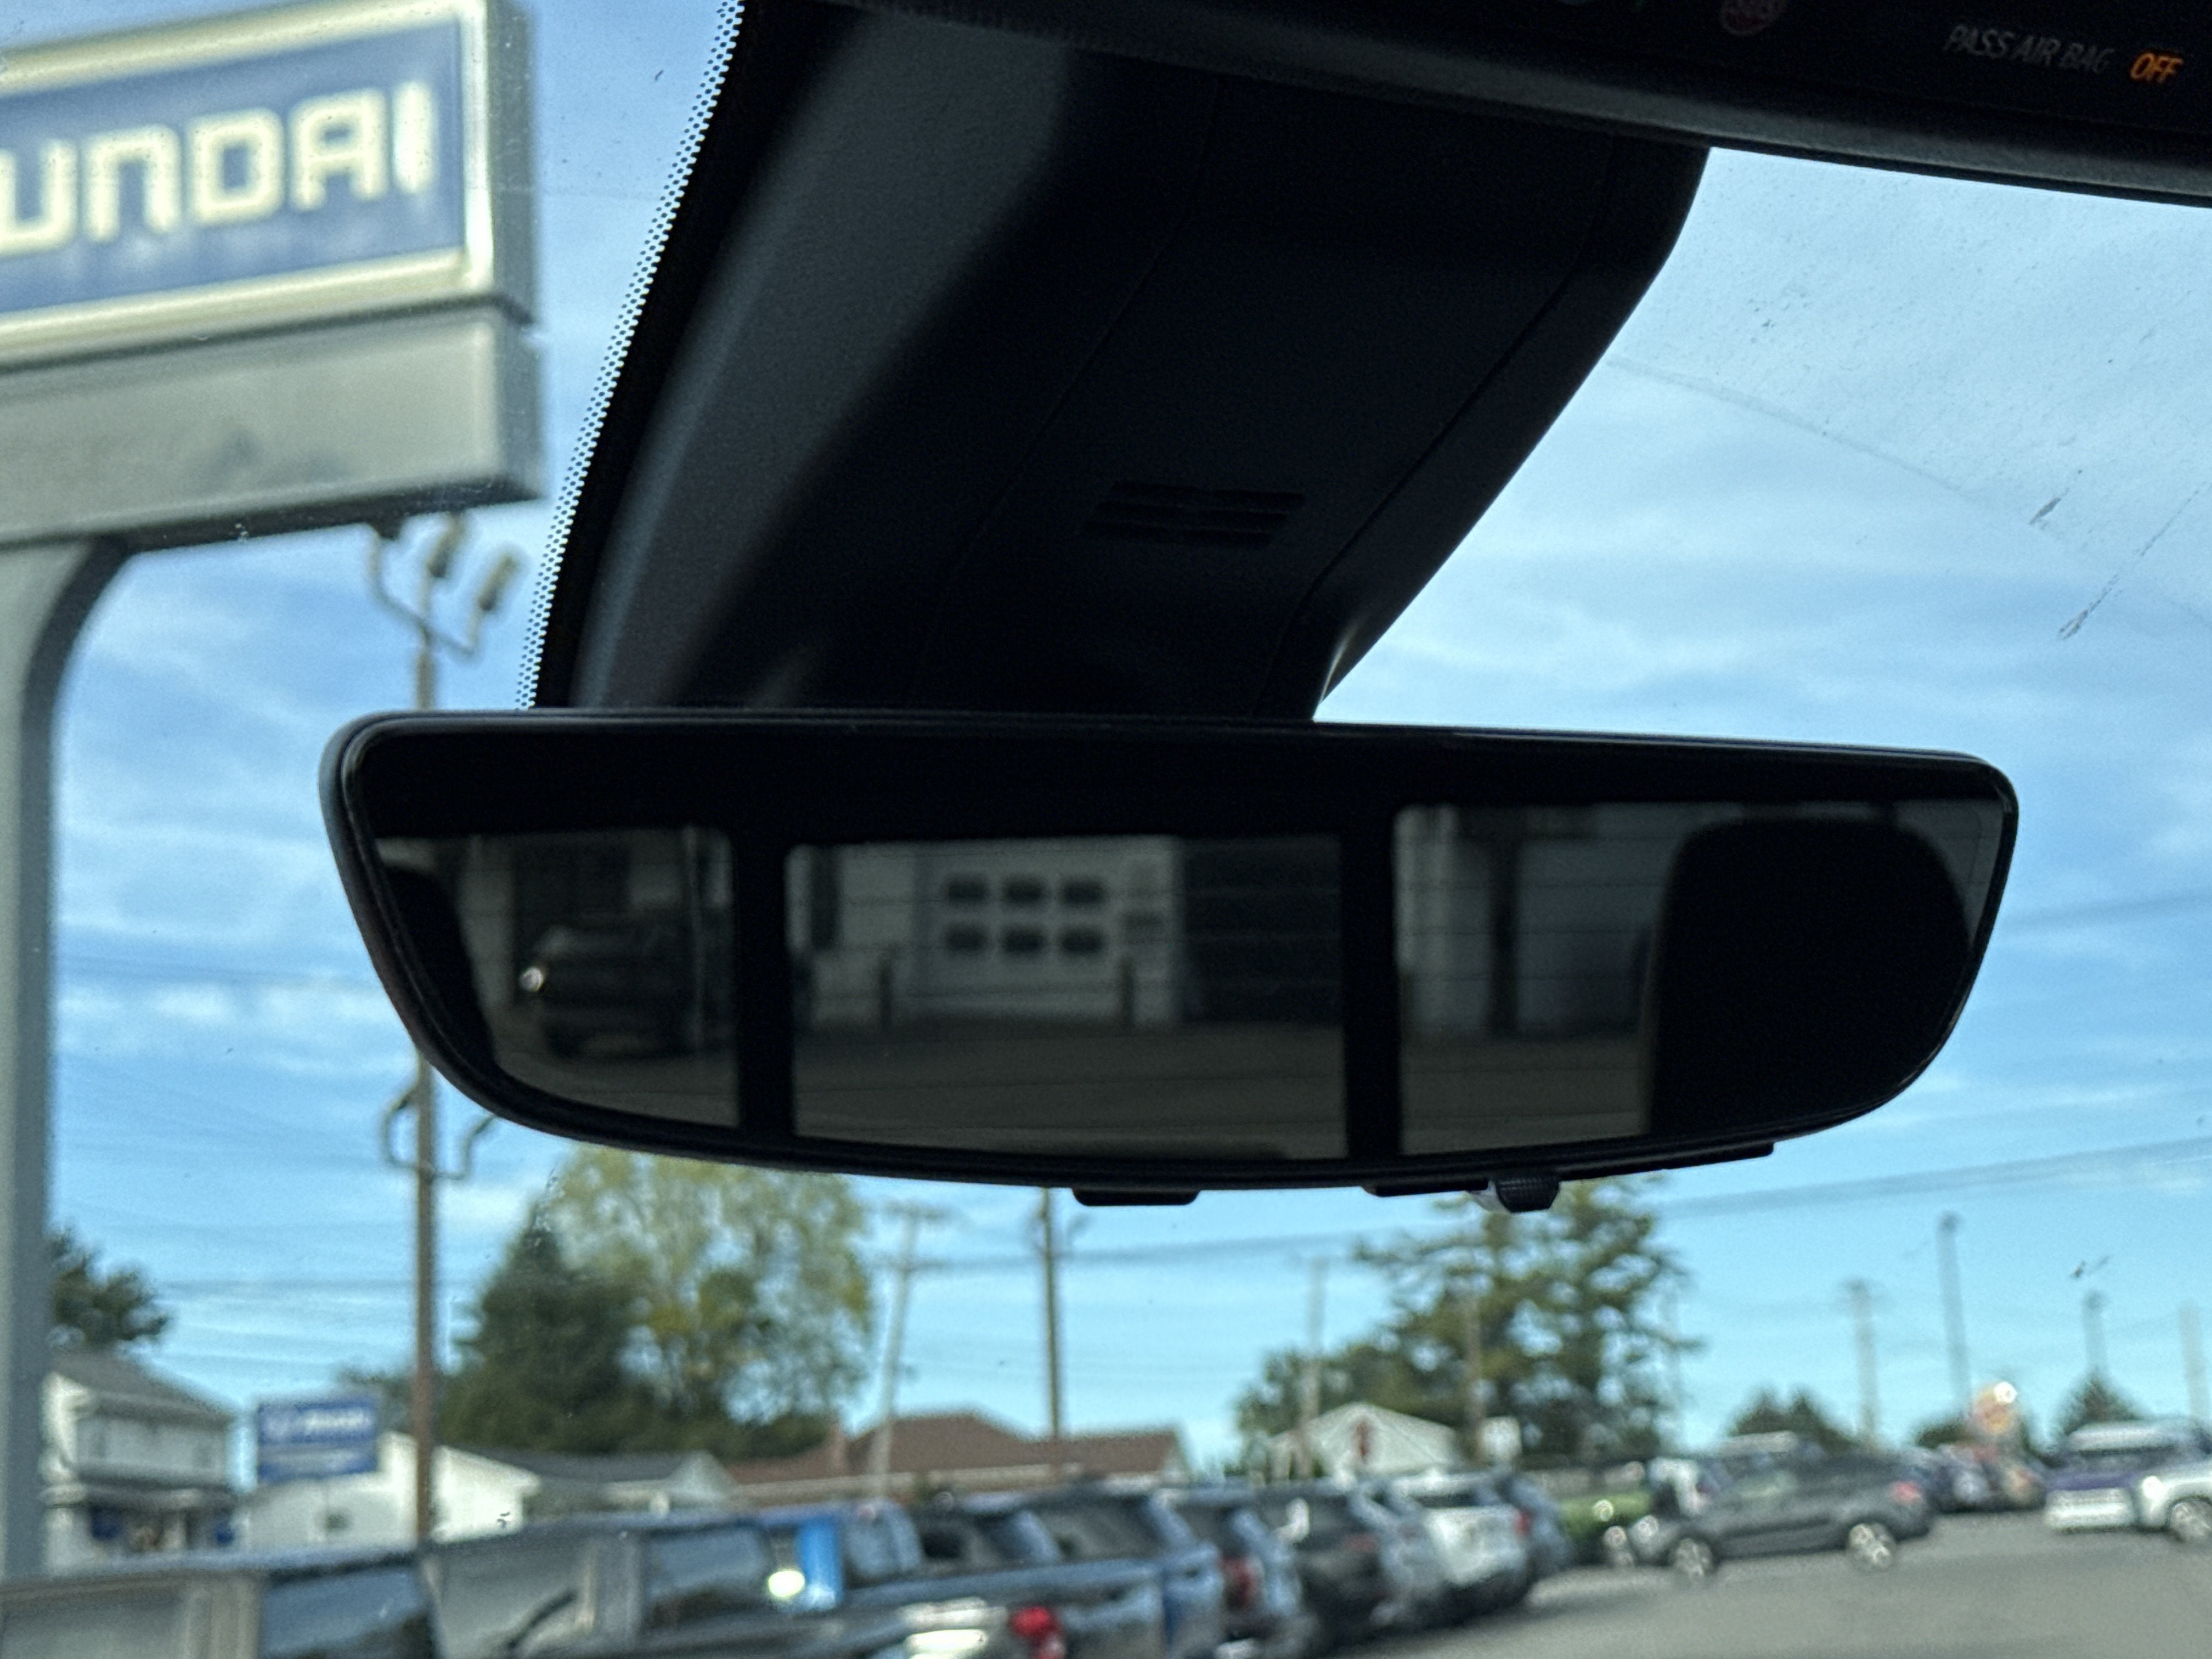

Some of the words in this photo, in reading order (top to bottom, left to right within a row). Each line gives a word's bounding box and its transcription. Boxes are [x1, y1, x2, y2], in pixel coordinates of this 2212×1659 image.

[1943, 24, 2015, 59] PASS
[2012, 35, 2061, 67] AIR
[2059, 43, 2115, 74] BAG
[2129, 52, 2184, 84] OFF
